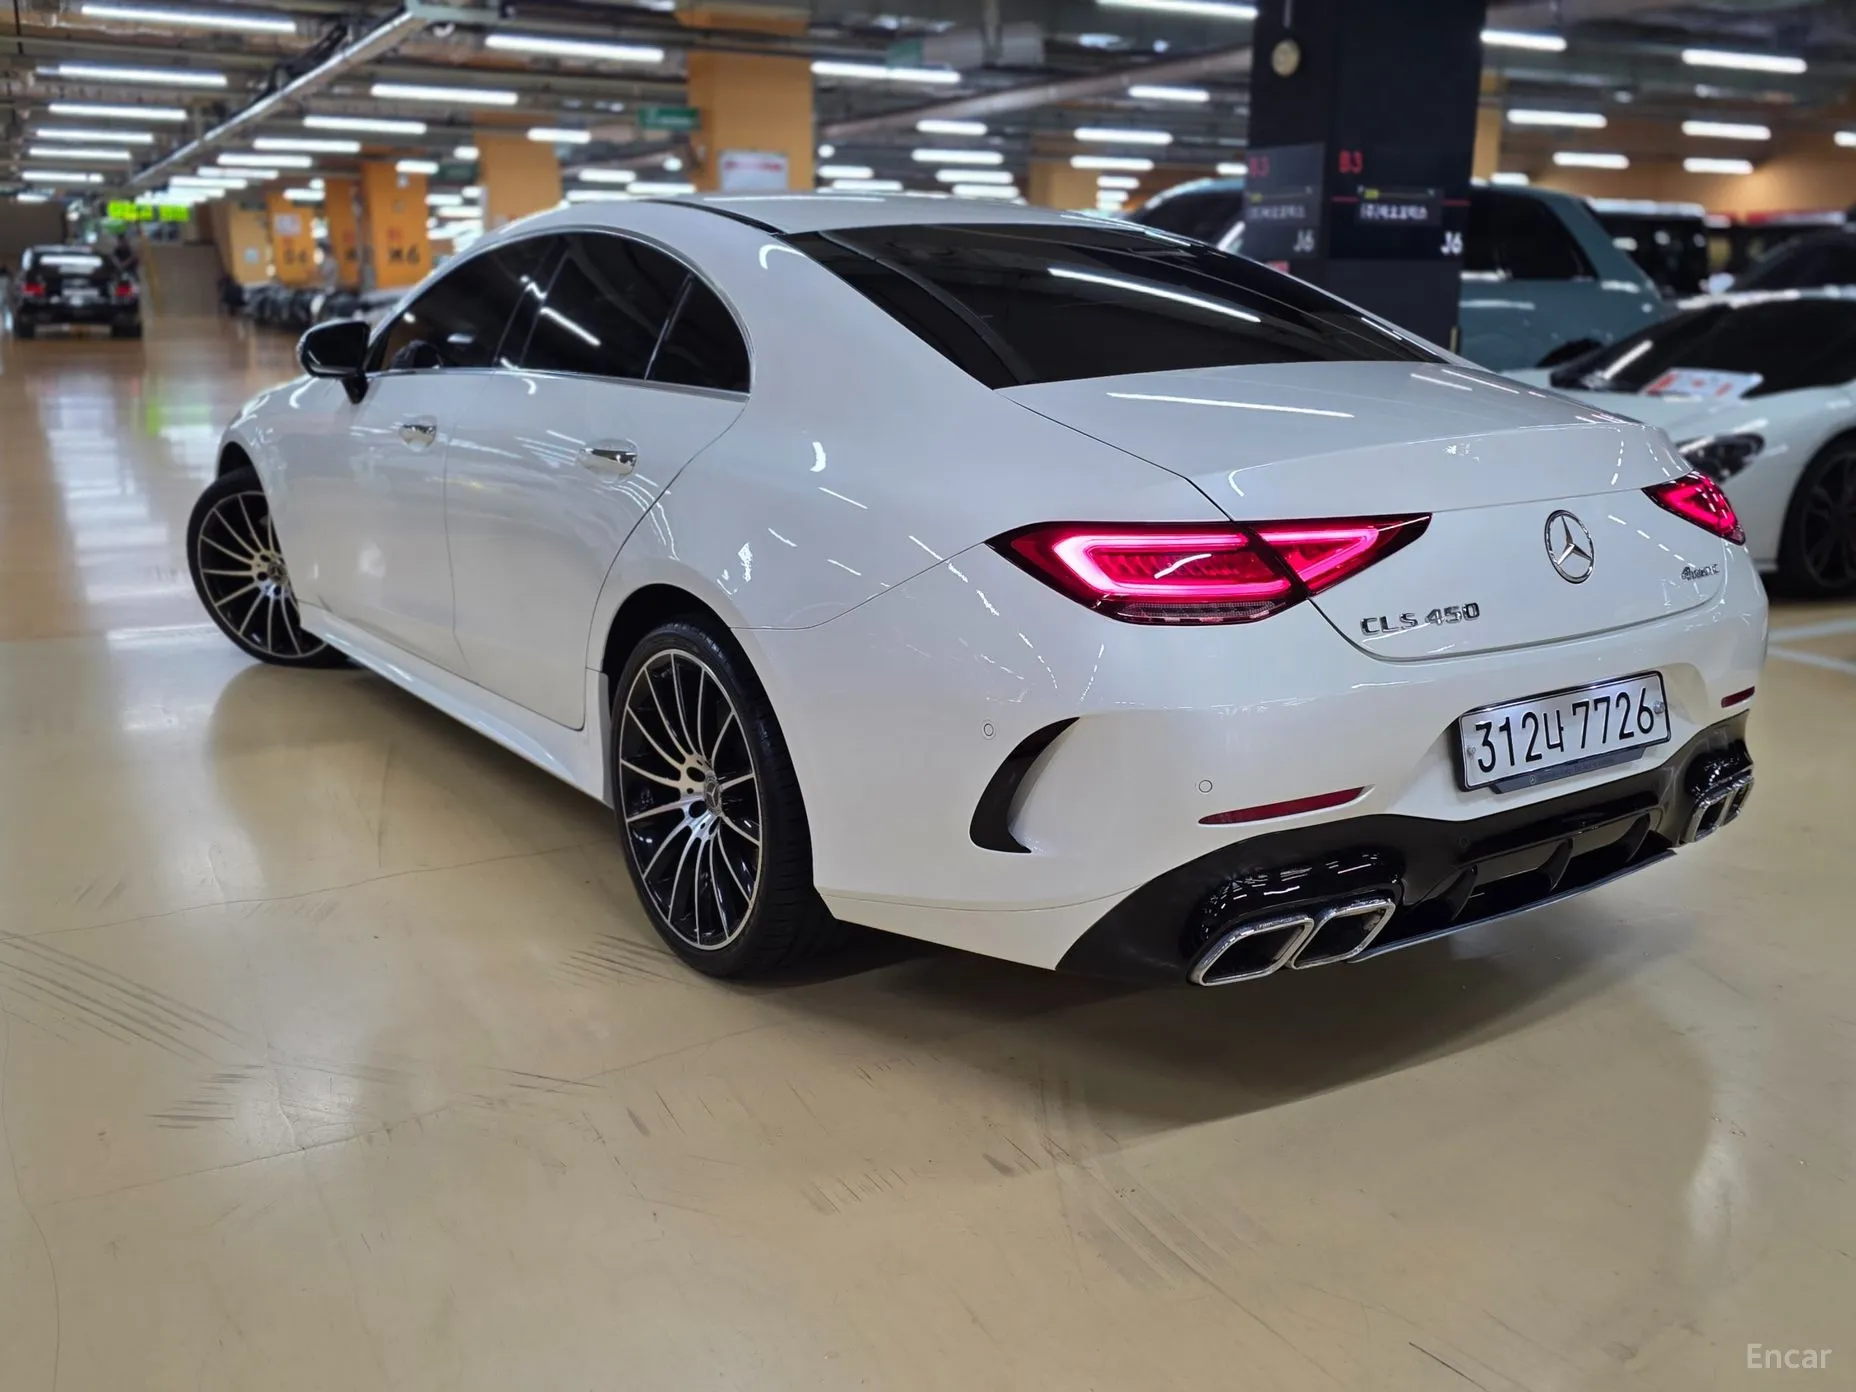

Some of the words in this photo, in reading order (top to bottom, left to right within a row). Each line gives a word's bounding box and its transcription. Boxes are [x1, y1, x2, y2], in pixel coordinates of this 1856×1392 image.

[1440, 230, 1464, 255] J6
[1360, 612, 1419, 636] CLS
[1425, 602, 1481, 626] 450
[1571, 687, 1655, 750] 7726
